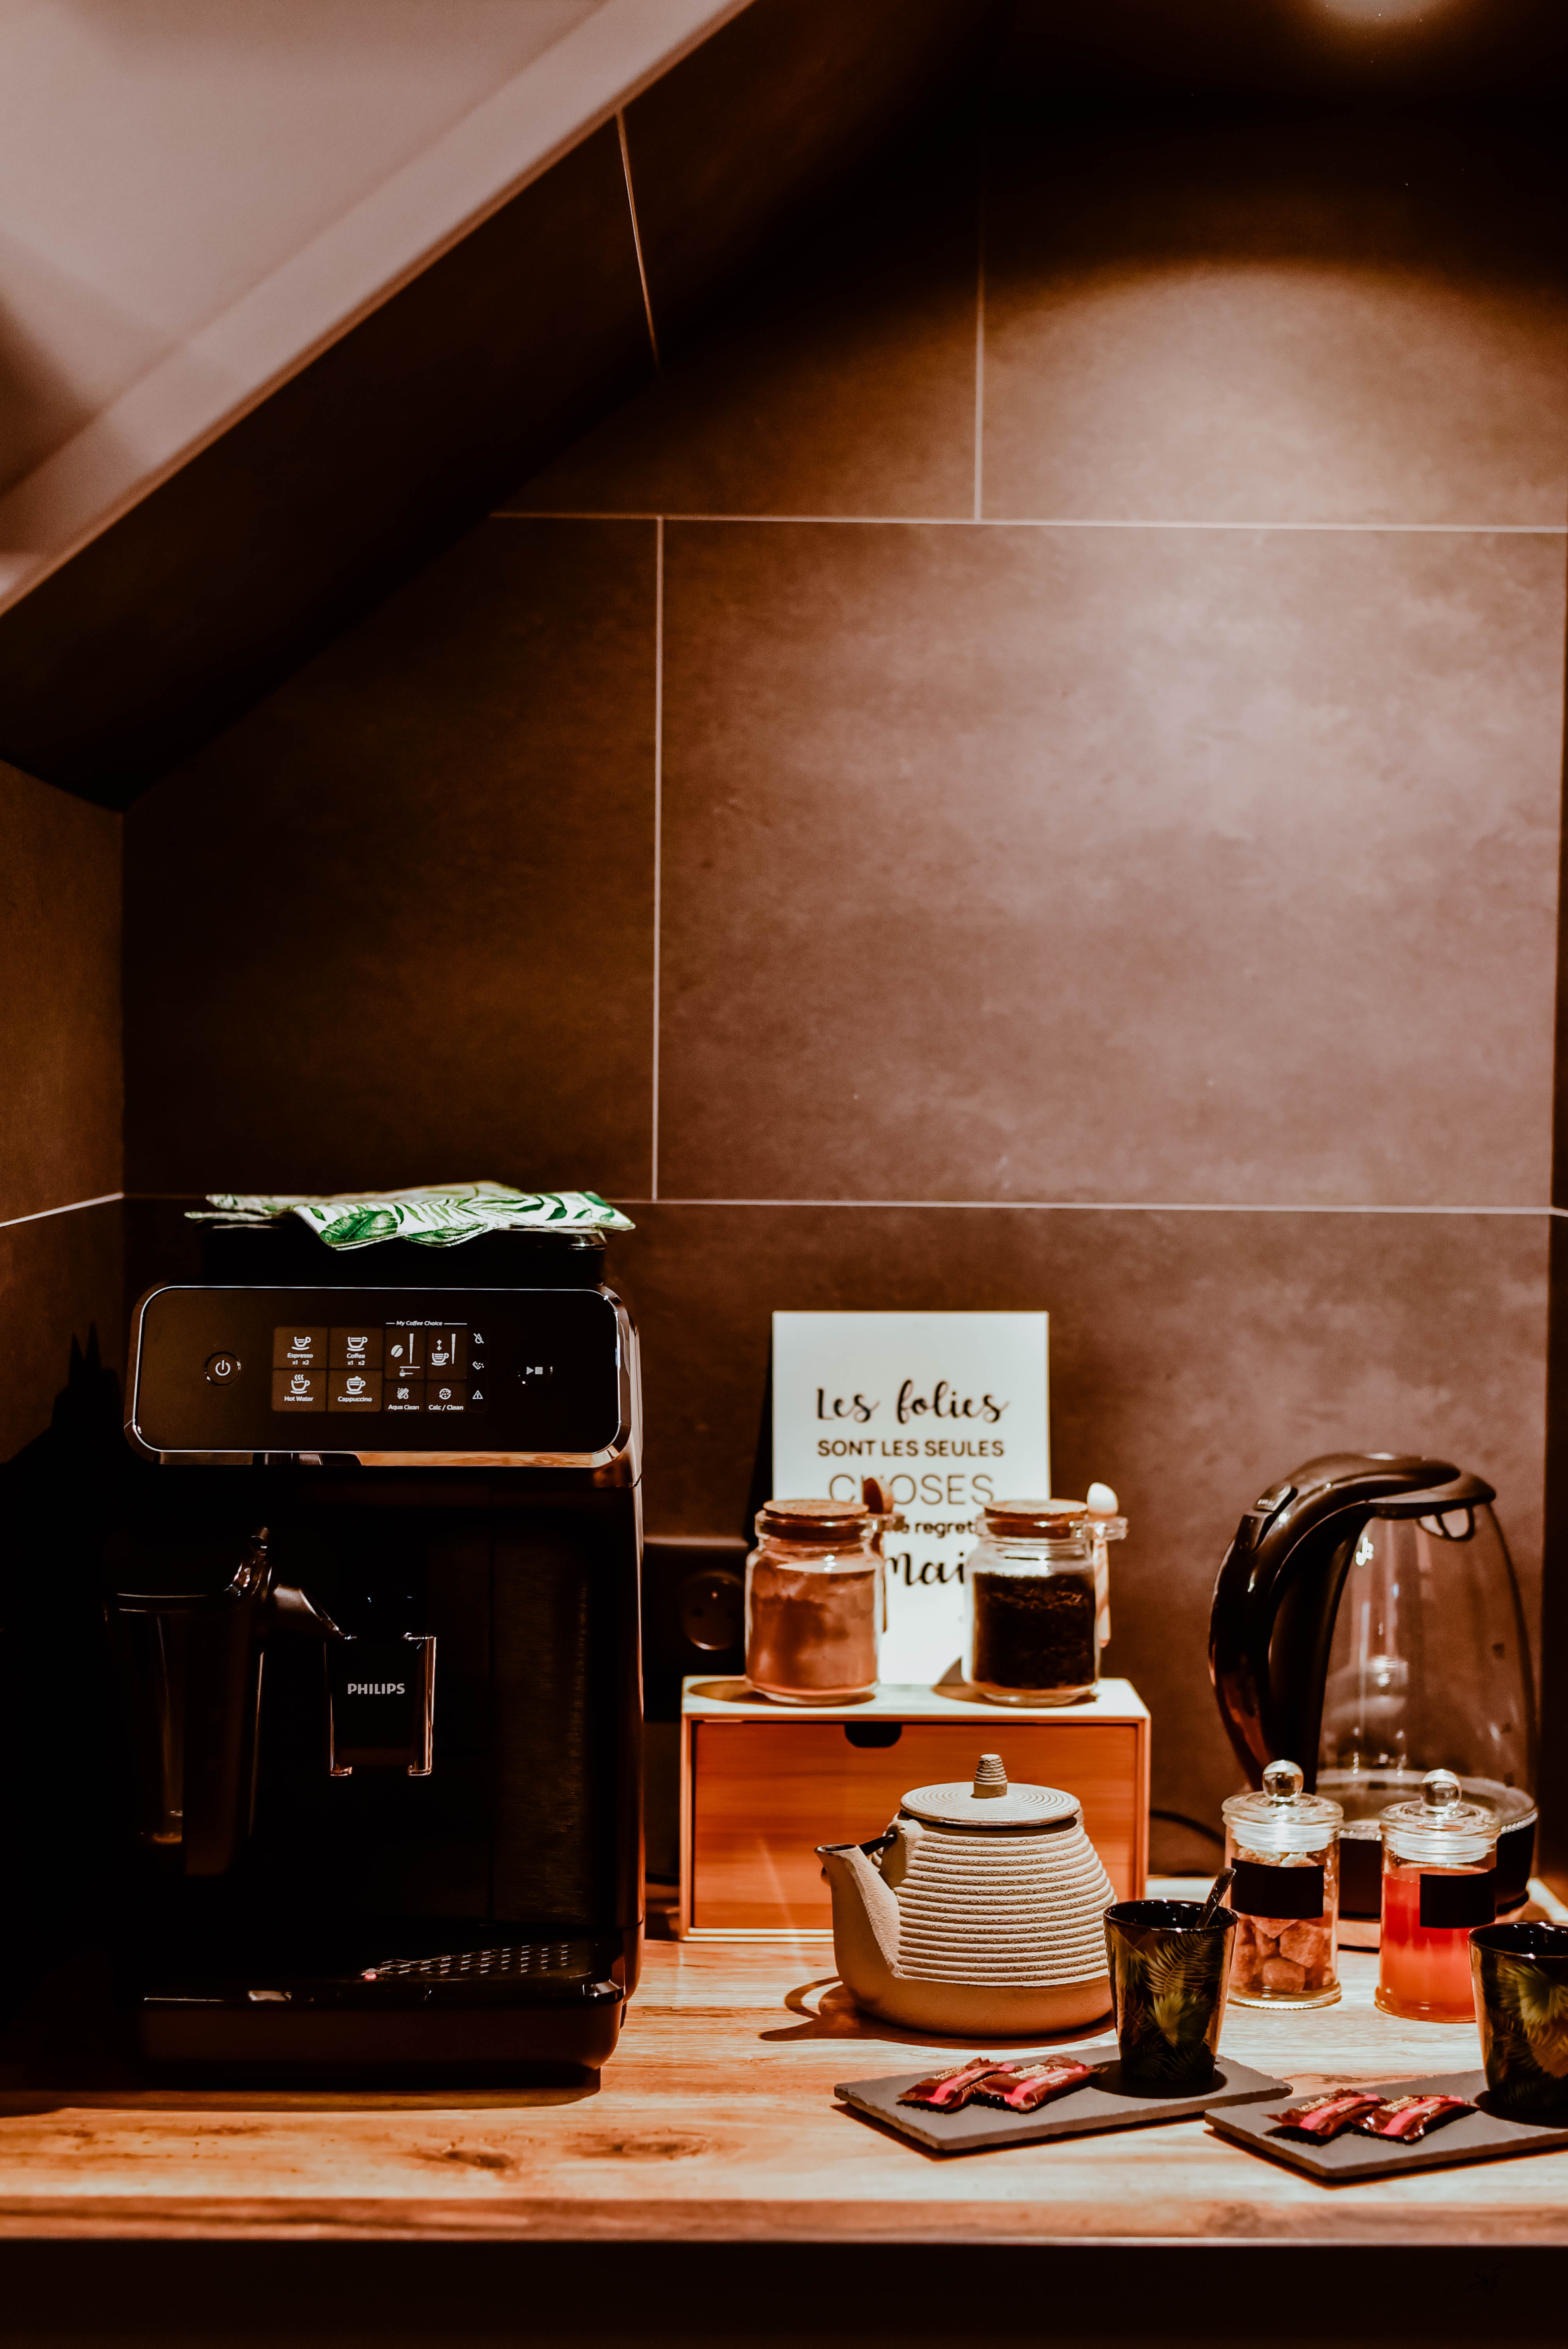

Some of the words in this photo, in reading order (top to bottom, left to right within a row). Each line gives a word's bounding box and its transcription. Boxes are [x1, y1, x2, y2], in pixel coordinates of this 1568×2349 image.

[816, 1387, 879, 1423] Les
[896, 1379, 1008, 1425] folies
[817, 1440, 876, 1457] SONT
[882, 1440, 919, 1457] LES
[924, 1440, 1005, 1457] SEULES
[829, 1474, 994, 1505] COSES
[915, 1520, 975, 1539] regret
[347, 1682, 405, 1695] PHILIPS
